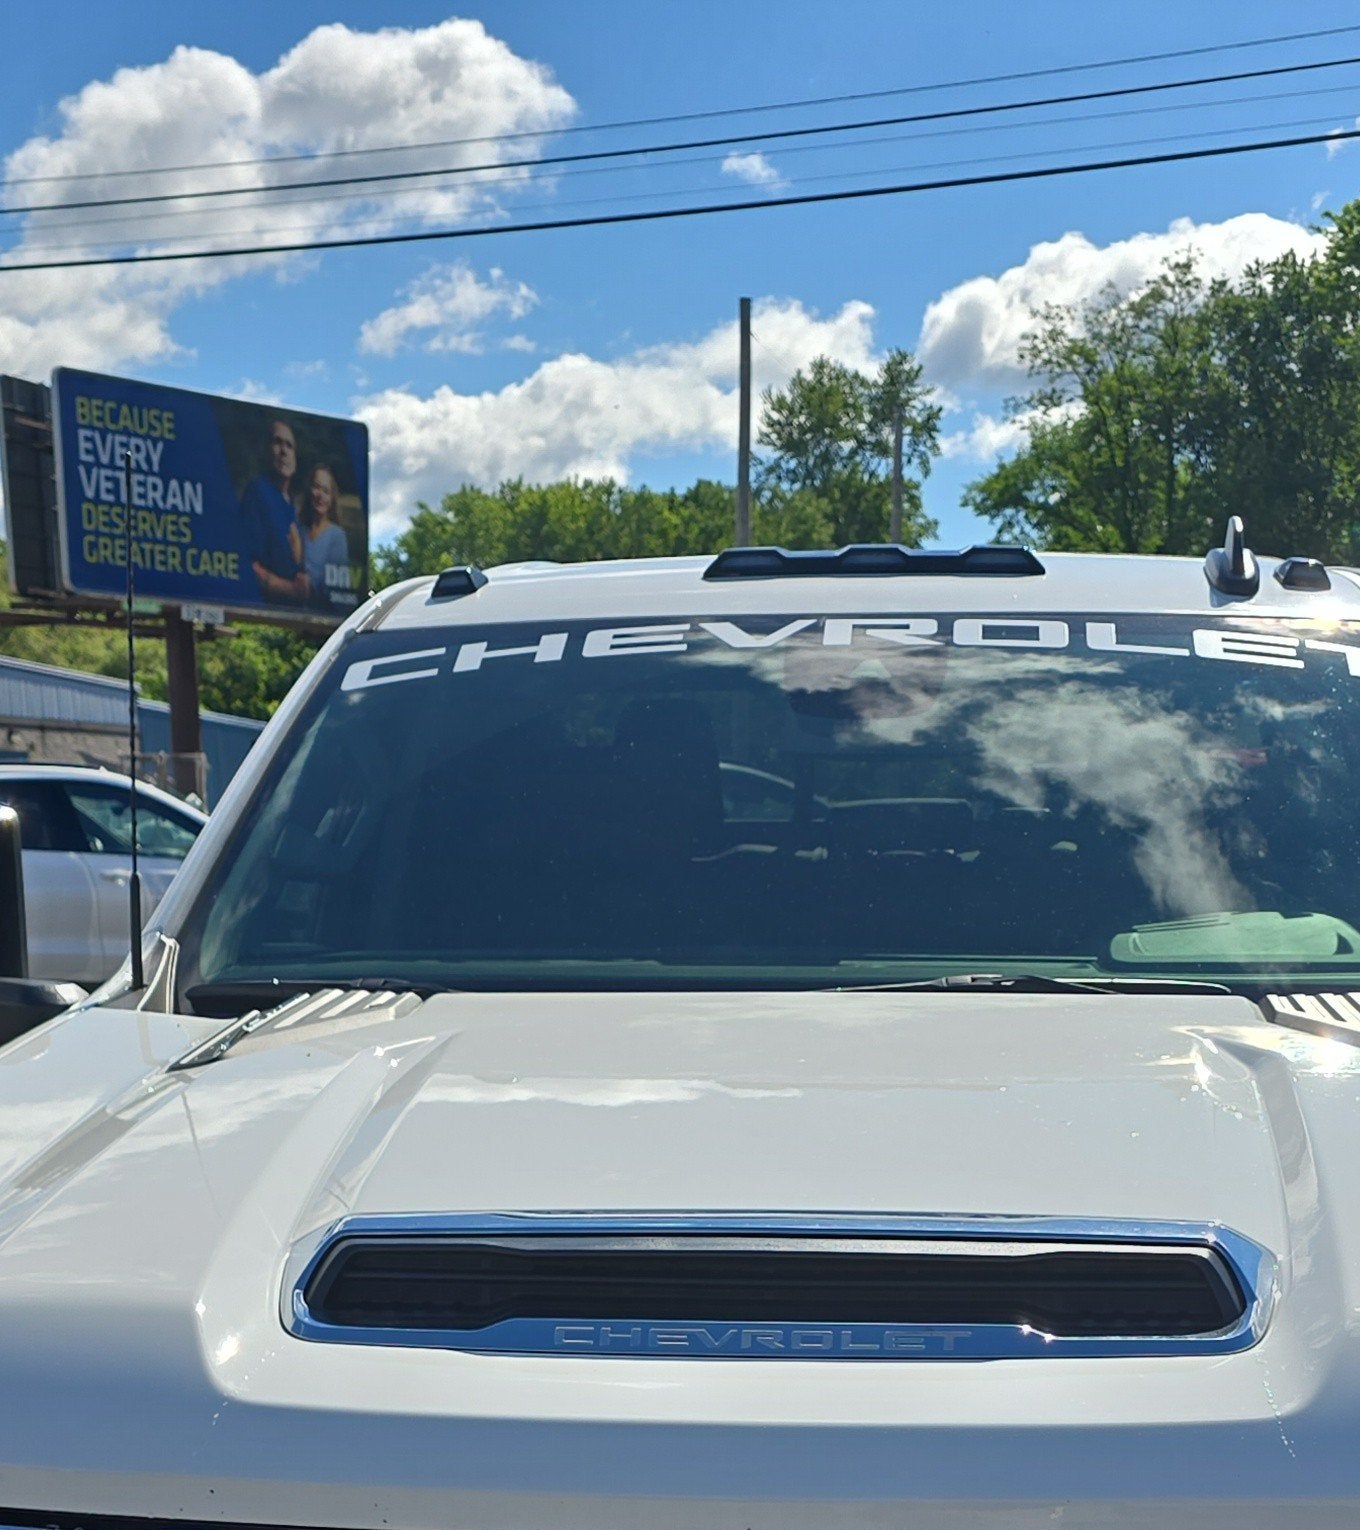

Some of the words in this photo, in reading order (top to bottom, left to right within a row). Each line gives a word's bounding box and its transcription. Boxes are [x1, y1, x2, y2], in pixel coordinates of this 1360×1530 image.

[75, 395, 175, 441] BECAUSE
[77, 428, 164, 473] EVERY
[78, 464, 204, 514] VETERAN
[82, 502, 192, 543] DESERVES
[83, 534, 184, 573] GREATER
[186, 548, 240, 580] CARE
[554, 1326, 972, 1351] CHEVROLET
